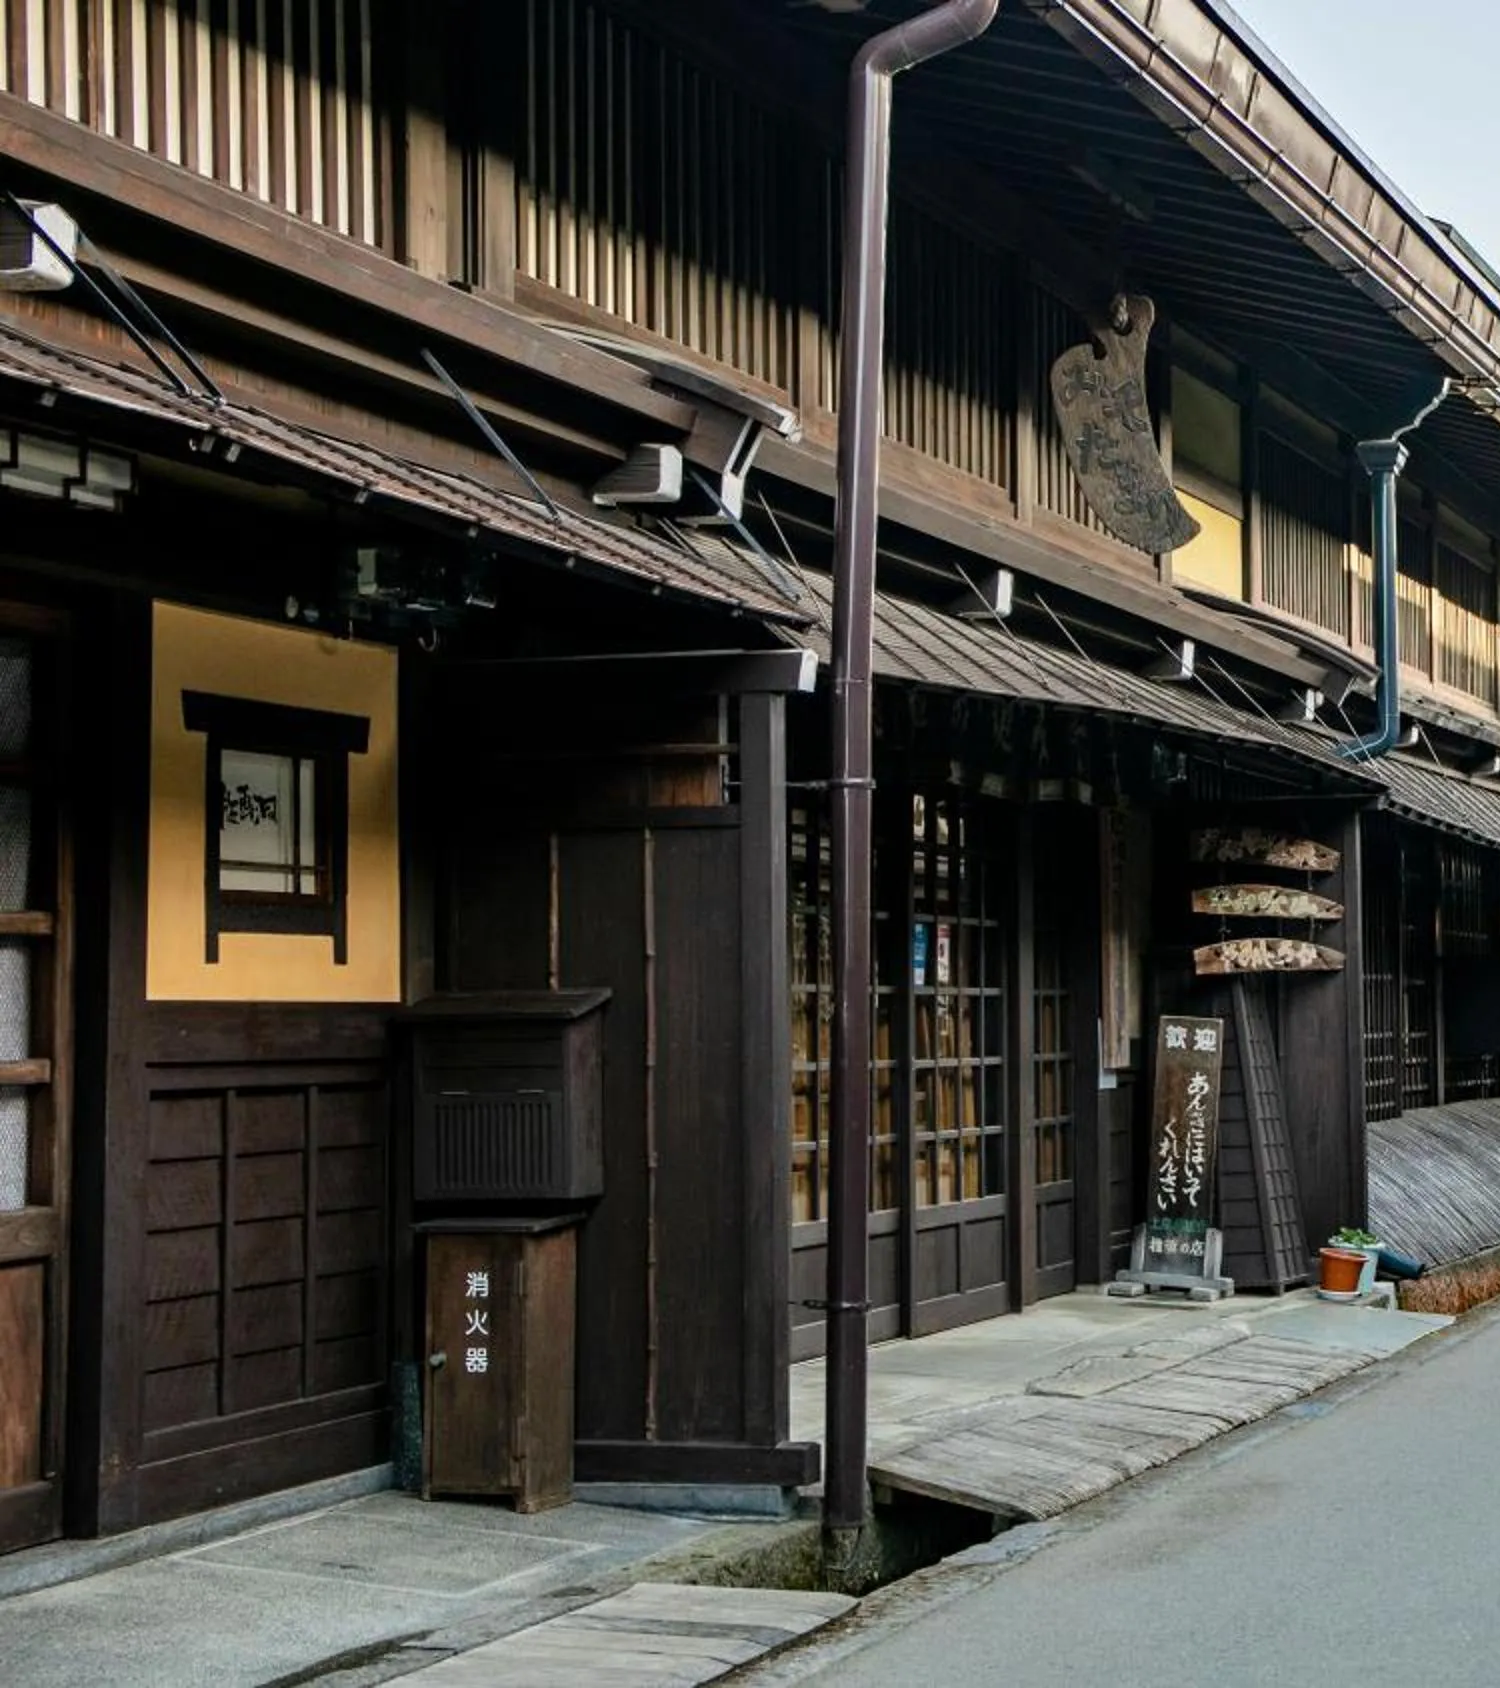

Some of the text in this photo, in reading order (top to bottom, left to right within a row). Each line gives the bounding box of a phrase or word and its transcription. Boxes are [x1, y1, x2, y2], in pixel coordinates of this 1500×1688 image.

[1165, 1025, 1217, 1052] 歓迎
[1156, 1117, 1181, 1211] くれんさい
[464, 1271, 489, 1373] 消火器
